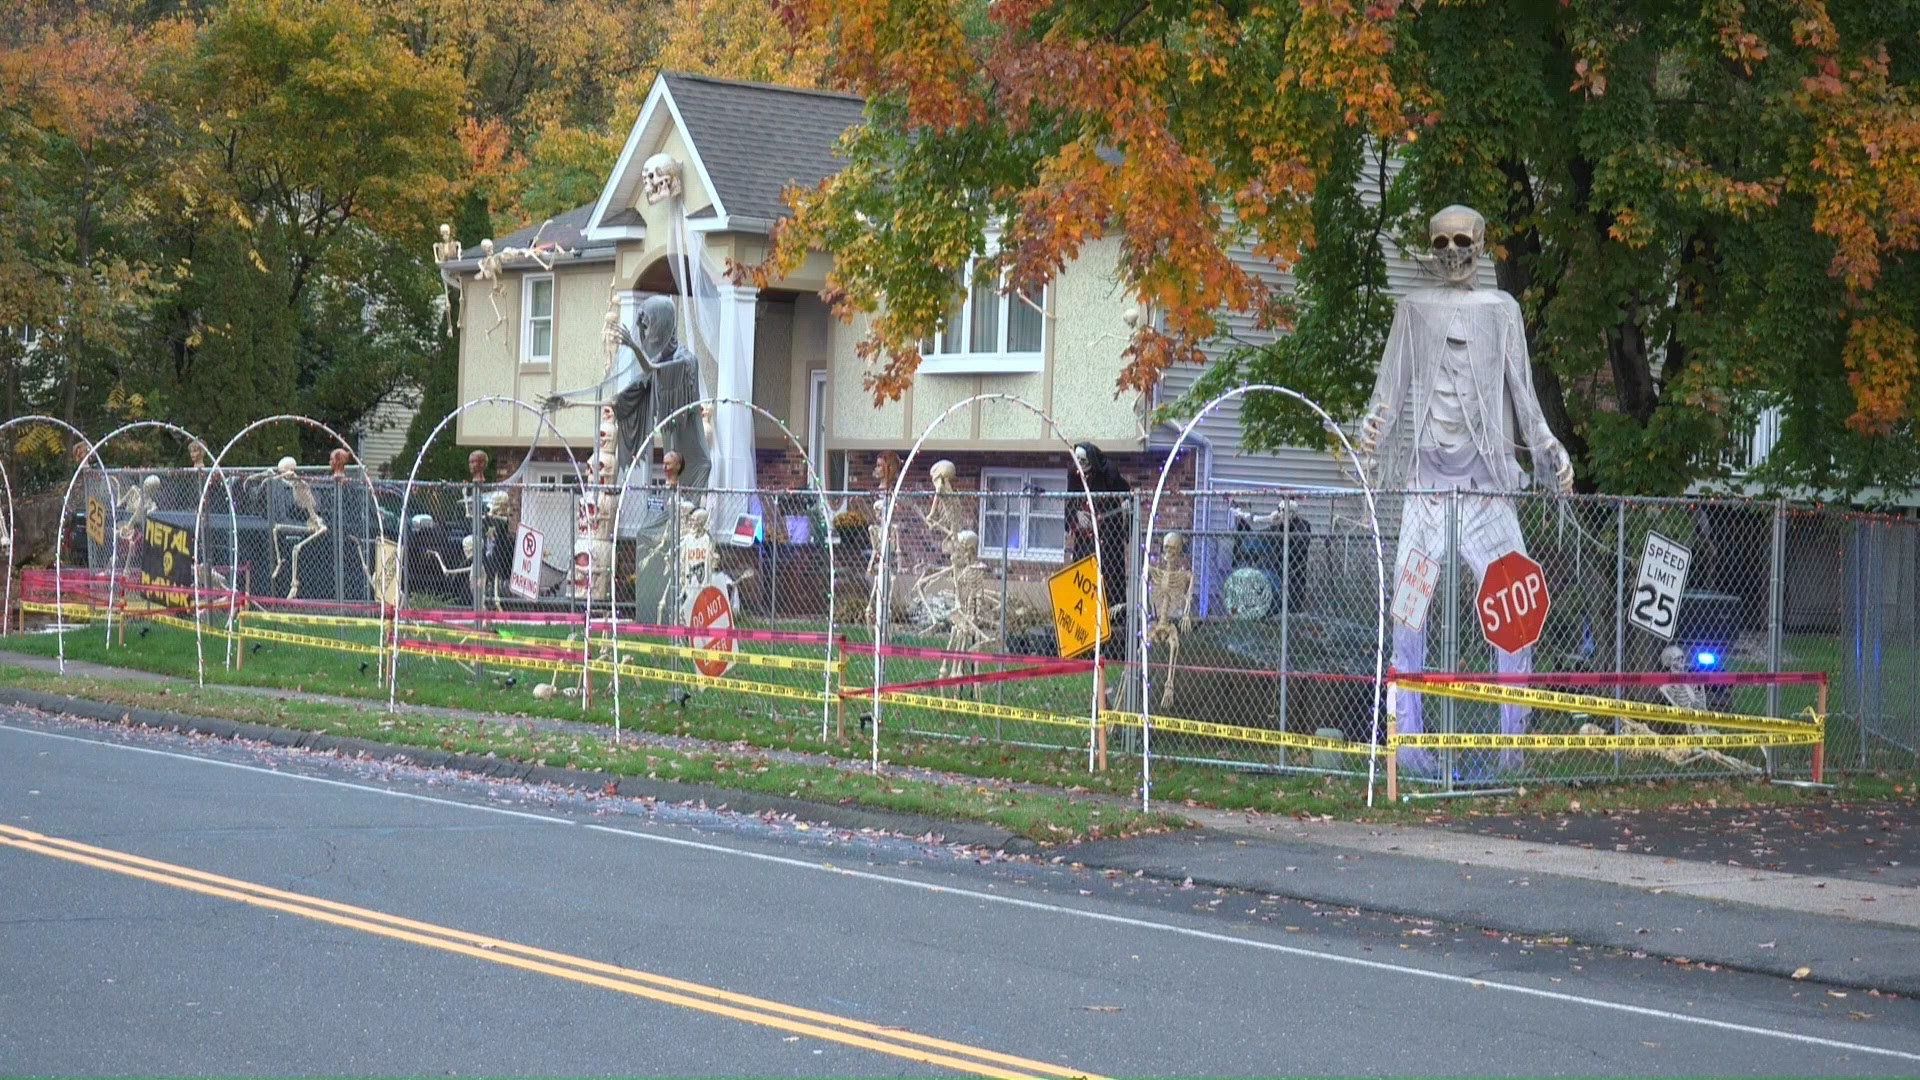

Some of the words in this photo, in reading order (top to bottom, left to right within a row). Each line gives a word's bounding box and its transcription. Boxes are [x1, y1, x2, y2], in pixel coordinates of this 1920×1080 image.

[90, 500, 103, 528] 25
[522, 559, 532, 574] NO
[1415, 560, 1429, 577] NO
[1648, 543, 1685, 570] SPEED
[511, 572, 537, 595] PARKING
[1073, 570, 1098, 600] NOT
[1647, 563, 1677, 588] LIMIT
[693, 611, 704, 628] DO
[706, 595, 722, 619] NOT
[1074, 598, 1084, 616] A
[1482, 573, 1540, 632] STOP
[1635, 584, 1675, 627] 25
[1057, 608, 1075, 634] THRU
[1074, 623, 1090, 645] WAY
[704, 637, 728, 666] ETER
[915, 696, 928, 705] CAUTION
[930, 698, 942, 706] CAUTION
[945, 700, 958, 709] CAUTION
[966, 704, 979, 712] CAUTION
[982, 705, 995, 714] CAUTION
[997, 706, 1011, 715] CAUTION
[1020, 709, 1033, 718] CAUTION
[1484, 686, 1502, 695] CAUTION
[1505, 689, 1524, 698] CAUTION
[1536, 691, 1554, 700] CAUTION
[1557, 694, 1575, 703] CAUTION
[1580, 696, 1597, 706] CAUTION
[1106, 713, 1120, 721] CAUTION
[1123, 714, 1137, 723] CAUTION
[1141, 716, 1156, 725] CION
[1166, 719, 1180, 728] CAUTION
[1183, 721, 1198, 731] CAUTION
[1201, 724, 1216, 733] CAUTION
[1227, 727, 1242, 736] CAUTION
[1245, 730, 1261, 739] CAUTION
[1265, 732, 1281, 741] CAUTION
[1292, 735, 1308, 744] CAUTION
[1311, 737, 1328, 746] CAUTION
[1398, 735, 1417, 744] CAUTION
[1420, 735, 1439, 744] CAUTION
[1443, 735, 1461, 744] CAUTION
[1473, 735, 1492, 744] CAUTION
[1495, 735, 1514, 744] CAUTION
[1517, 735, 1535, 744] CAUTION
[1547, 736, 1564, 745] CAUTION
[1567, 736, 1585, 745] CAUTION
[1588, 736, 1606, 745] CAUTION
[1617, 736, 1635, 745] CAUTION
[1638, 736, 1655, 745] CAUTION
[1658, 736, 1675, 745] CAUTION
[1687, 736, 1703, 745] CAUTION
[1706, 736, 1723, 745] CAUTION
[1725, 736, 1743, 745] CAUTION
[1752, 736, 1769, 744] CAUTION
